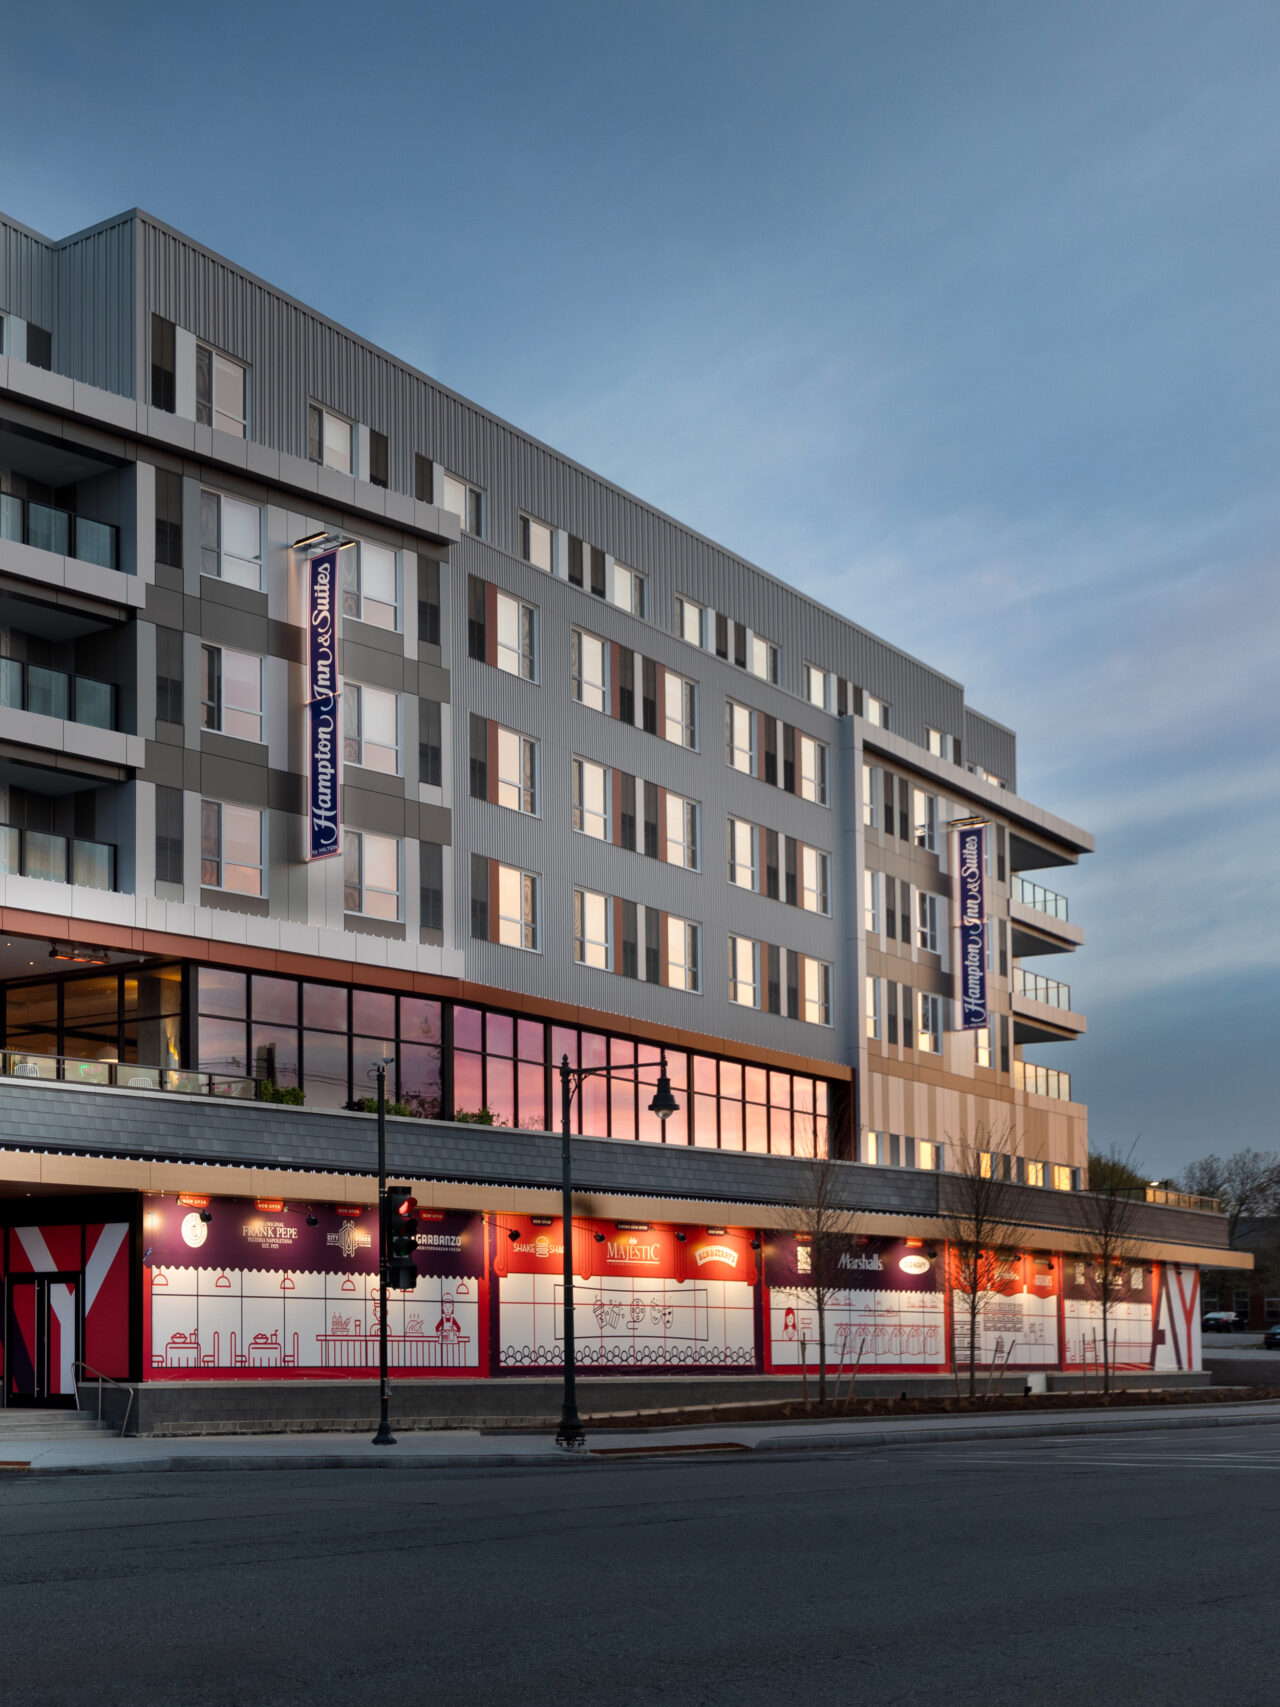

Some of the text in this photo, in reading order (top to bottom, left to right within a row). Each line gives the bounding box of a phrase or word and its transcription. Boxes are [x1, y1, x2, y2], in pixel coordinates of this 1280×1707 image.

[312, 562, 337, 846] Hampton Inn & Suites
[961, 835, 980, 881] Suites
[963, 892, 982, 935] Inn
[964, 936, 986, 1023] Hampton
[242, 1225, 298, 1239] FRANK PEPE
[416, 1234, 462, 1246] GARBANZO
[513, 1243, 564, 1254] SHAKE SHA
[607, 1241, 661, 1261] MAJESTIC
[838, 1252, 883, 1271] Marshalls
